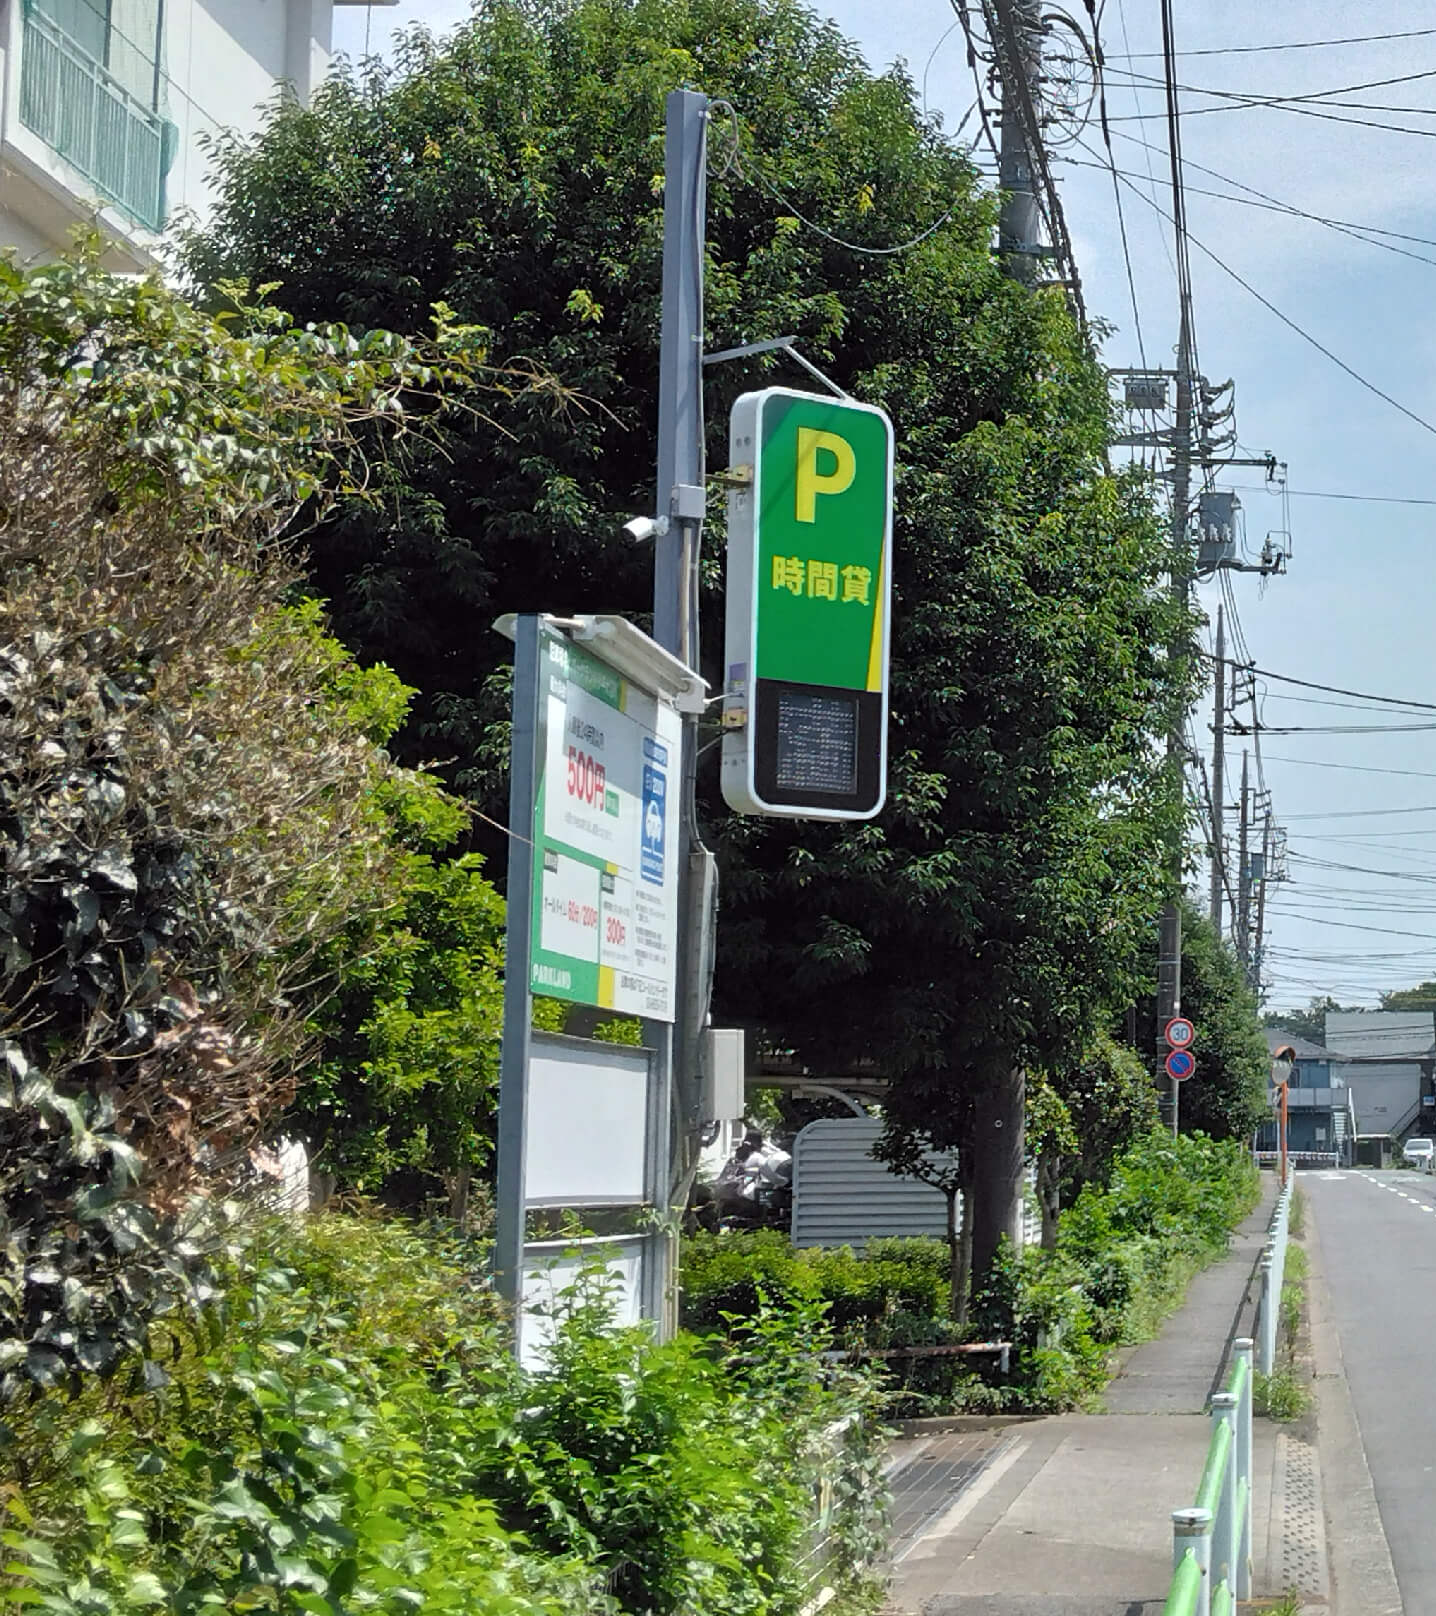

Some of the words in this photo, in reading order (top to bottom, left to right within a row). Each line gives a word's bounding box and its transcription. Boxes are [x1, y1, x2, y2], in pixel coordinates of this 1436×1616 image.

[795, 425, 856, 523] P
[772, 554, 872, 606] 時間貸
[567, 744, 606, 812] 500円
[1172, 1027, 1189, 1041] 30
